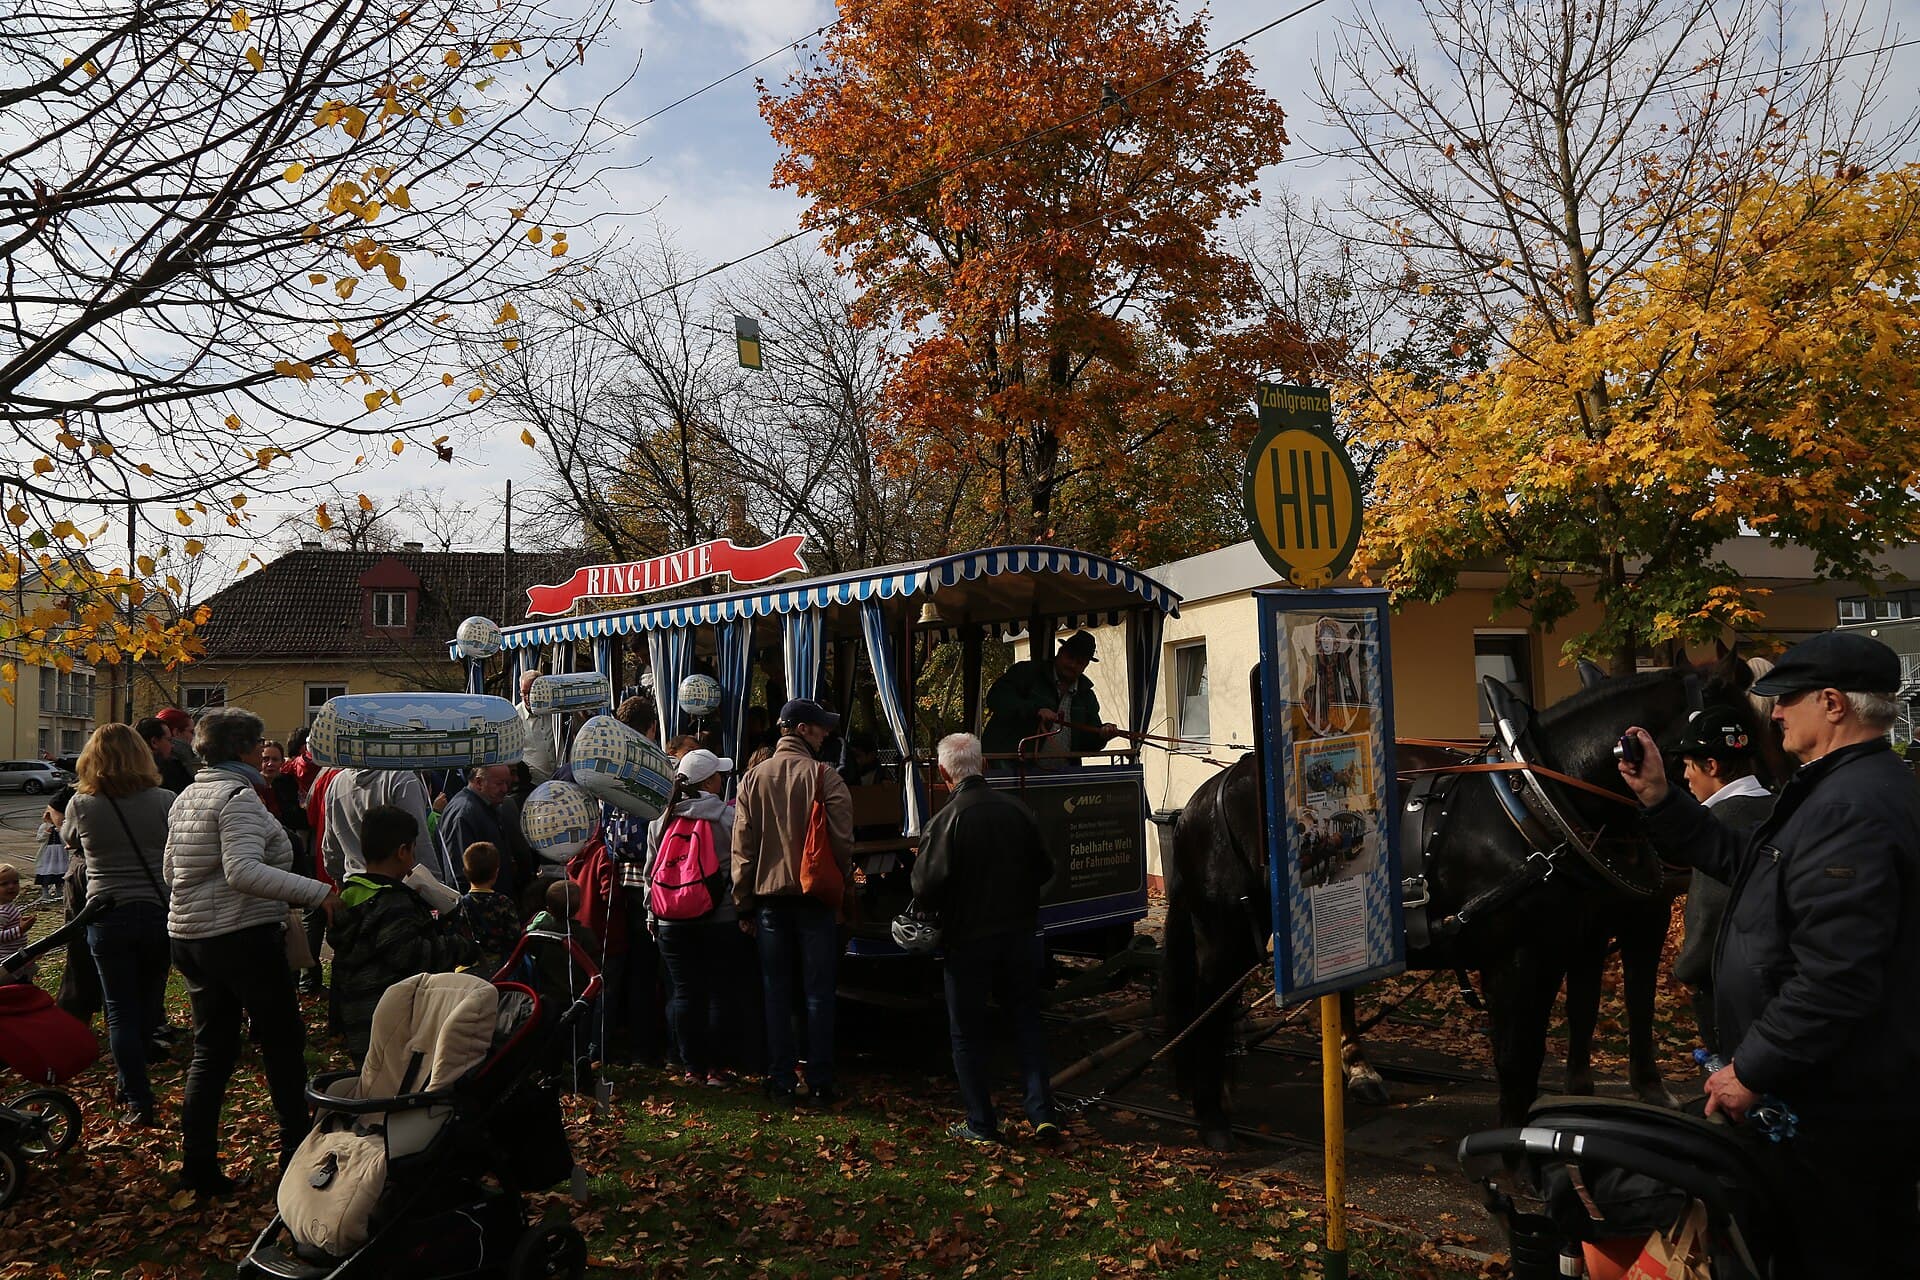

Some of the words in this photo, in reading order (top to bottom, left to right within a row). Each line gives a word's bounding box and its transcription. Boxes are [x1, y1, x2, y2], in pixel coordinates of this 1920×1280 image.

[1260, 386, 1330, 414] Zahlgrenze
[587, 545, 713, 595] RINGLINIE
[1076, 794, 1102, 806] MVG
[1070, 839, 1112, 856] Fabelhafte
[1114, 837, 1132, 851] Welt
[1070, 858, 1084, 871] der
[1085, 852, 1130, 869] Fahrmobile
